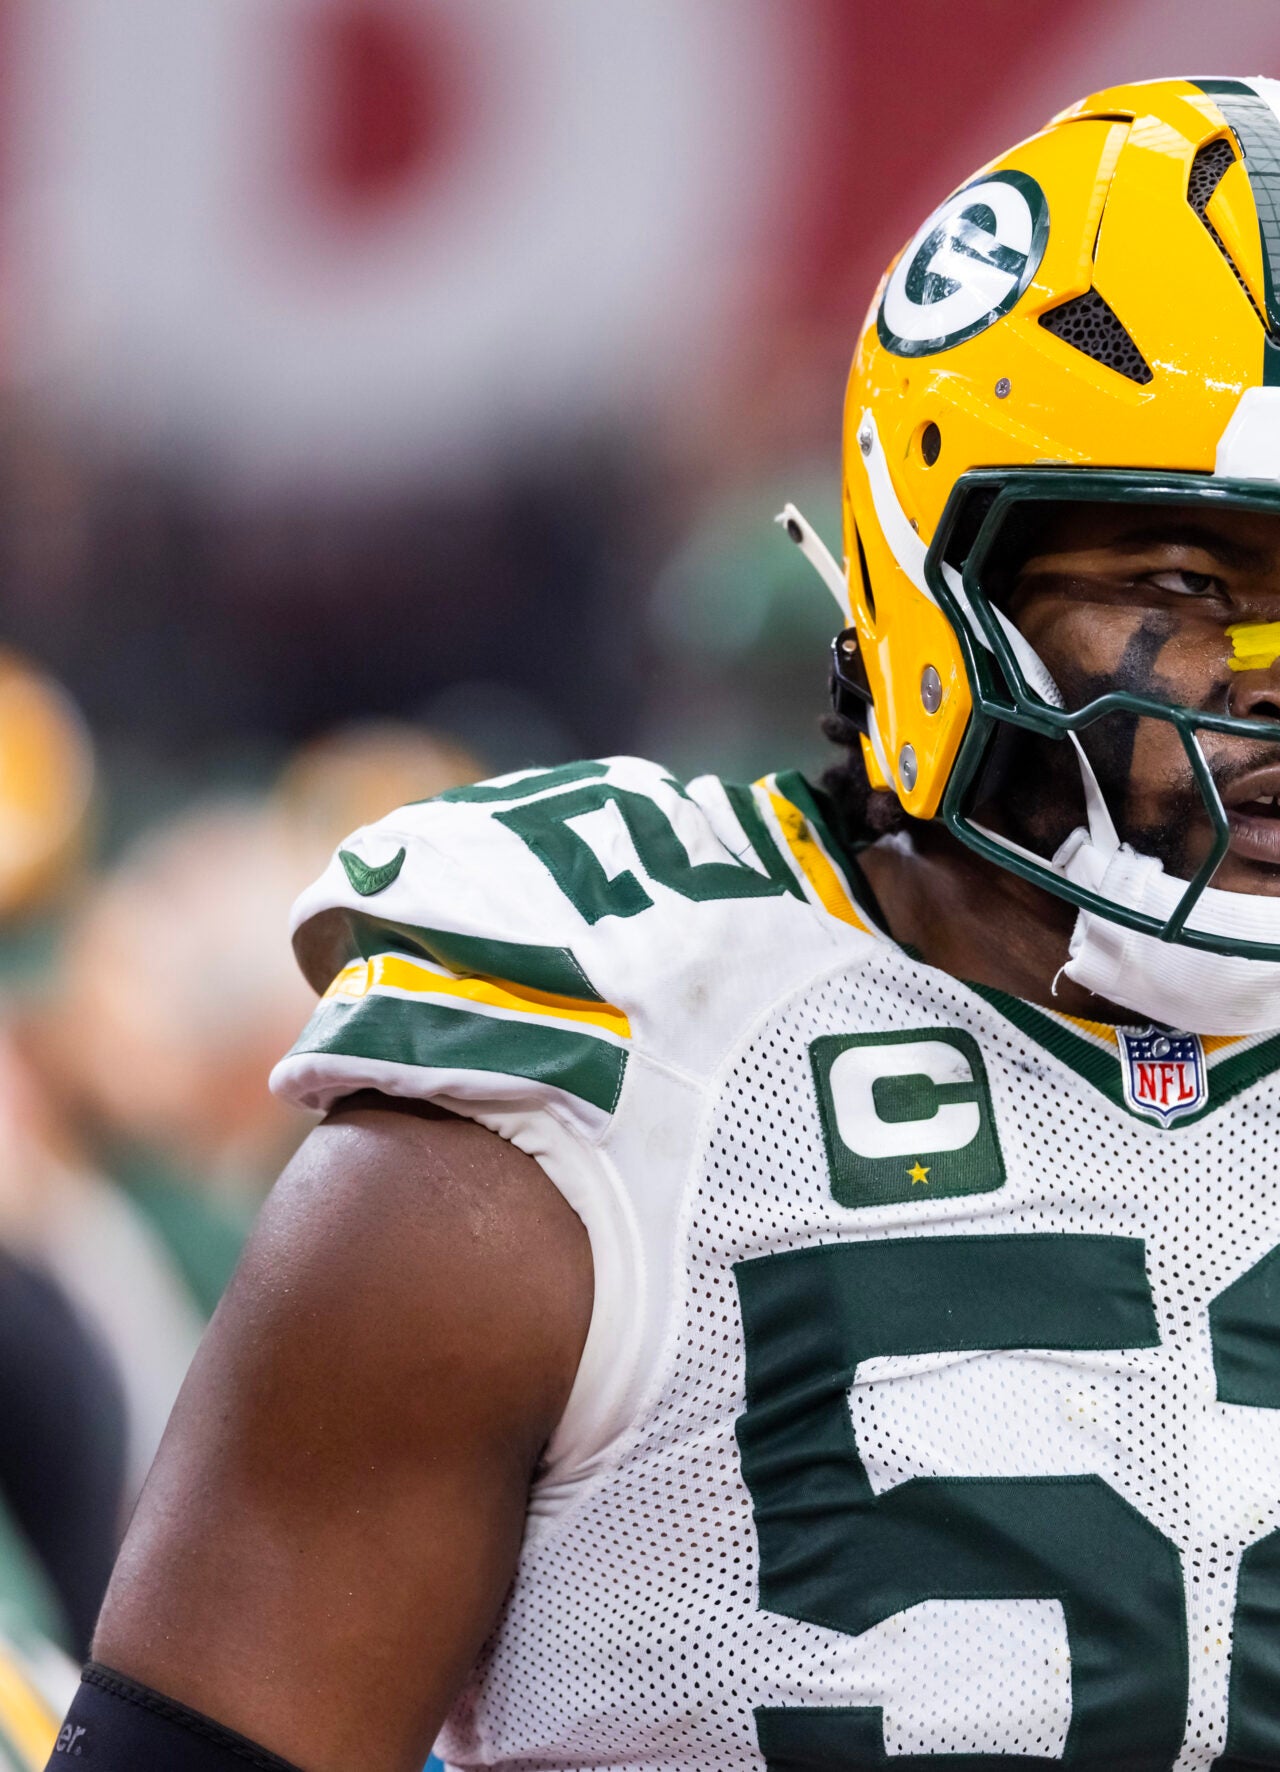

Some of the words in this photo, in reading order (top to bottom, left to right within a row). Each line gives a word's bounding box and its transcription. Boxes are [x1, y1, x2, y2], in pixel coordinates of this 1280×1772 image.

[884, 181, 1033, 340] G
[829, 1040, 983, 1159] C
[1136, 1063, 1194, 1106] NFL
